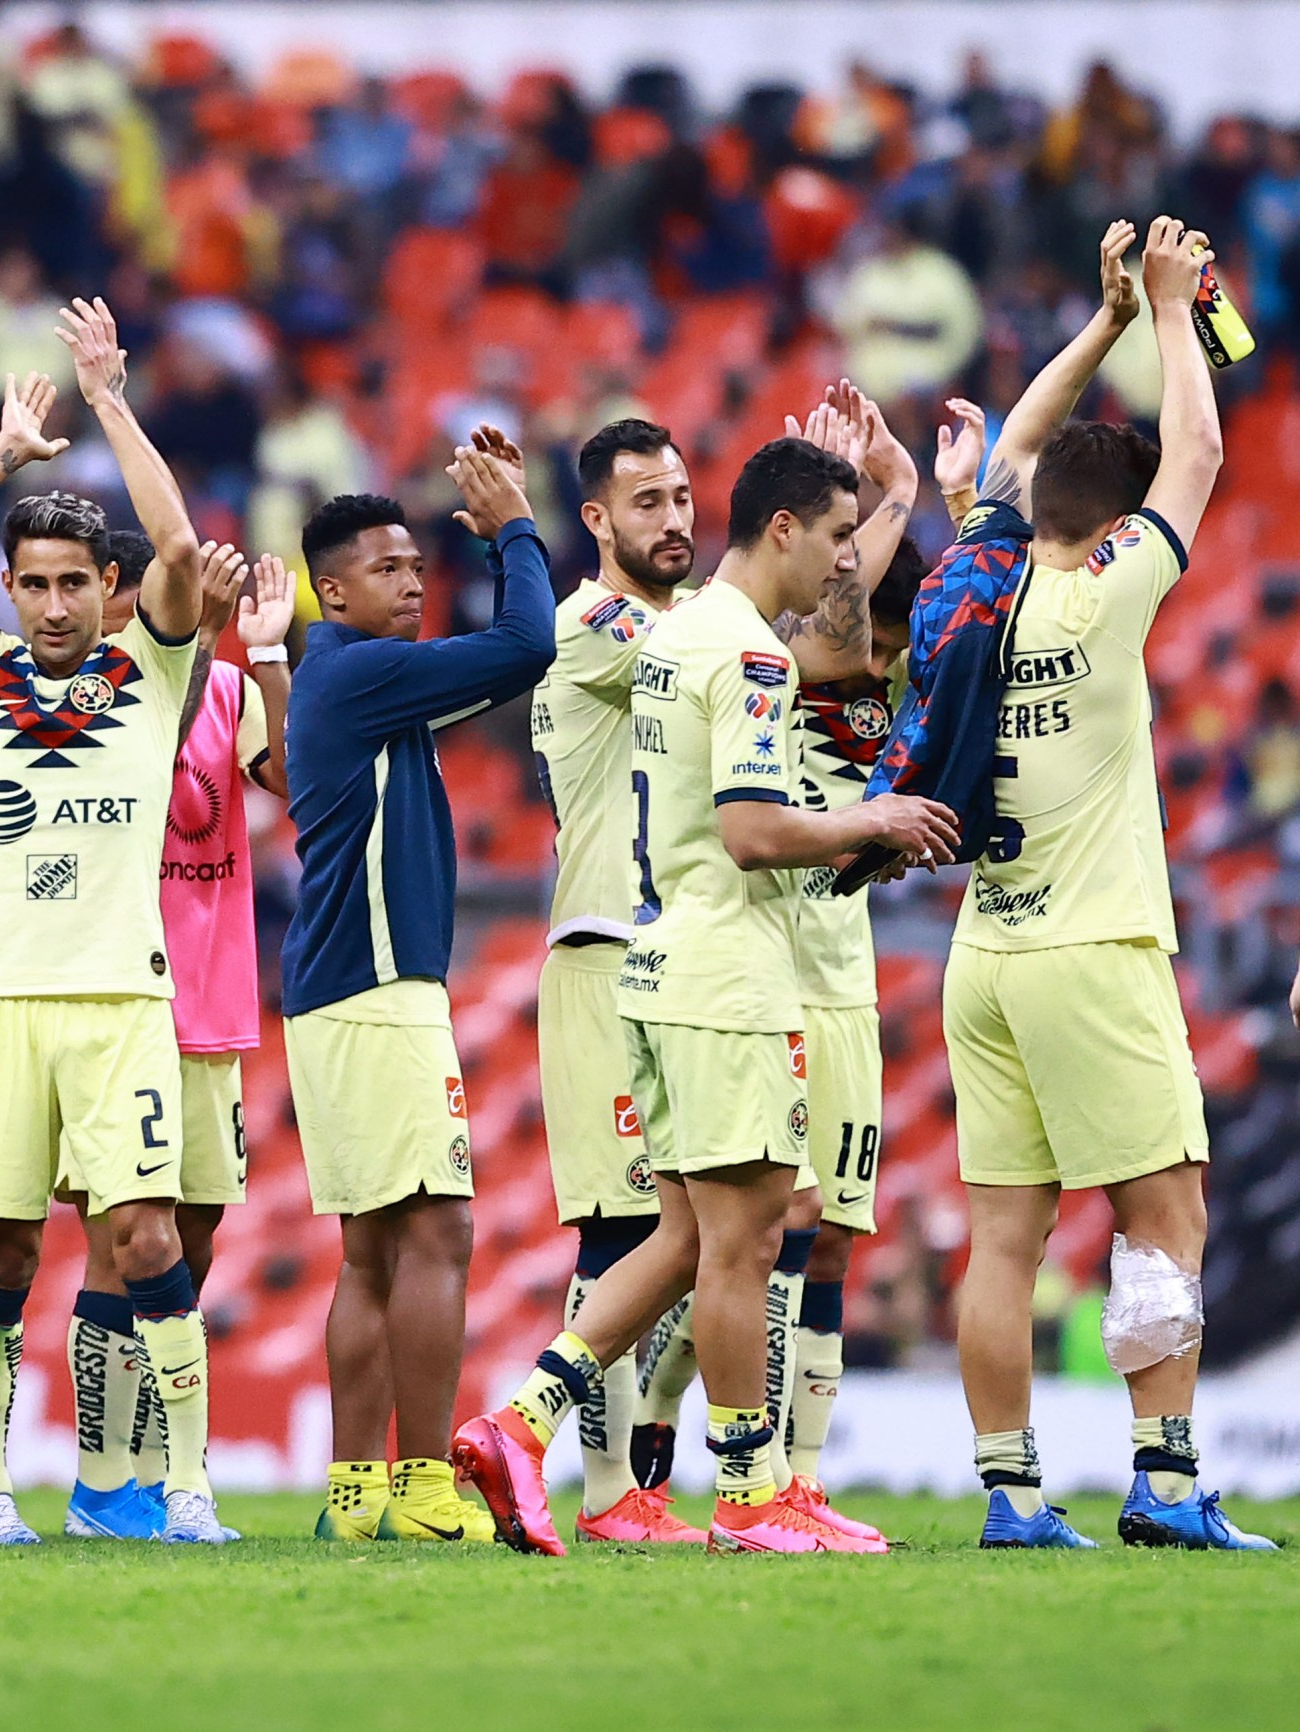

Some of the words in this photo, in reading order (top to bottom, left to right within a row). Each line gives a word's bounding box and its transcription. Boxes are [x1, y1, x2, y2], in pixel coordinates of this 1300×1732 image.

[1000, 700, 1070, 739] ERES
[52, 797, 138, 824] AT&T
[27, 855, 77, 899] HOME
[32, 859, 52, 877] THE
[803, 867, 838, 898] HOM
[47, 872, 76, 899] DEPOT
[134, 1088, 169, 1149] 2
[835, 1121, 878, 1182] 18
[124, 1358, 140, 1372] C
[74, 1320, 110, 1453] BRIDGESTO
[172, 1374, 201, 1390] CA
